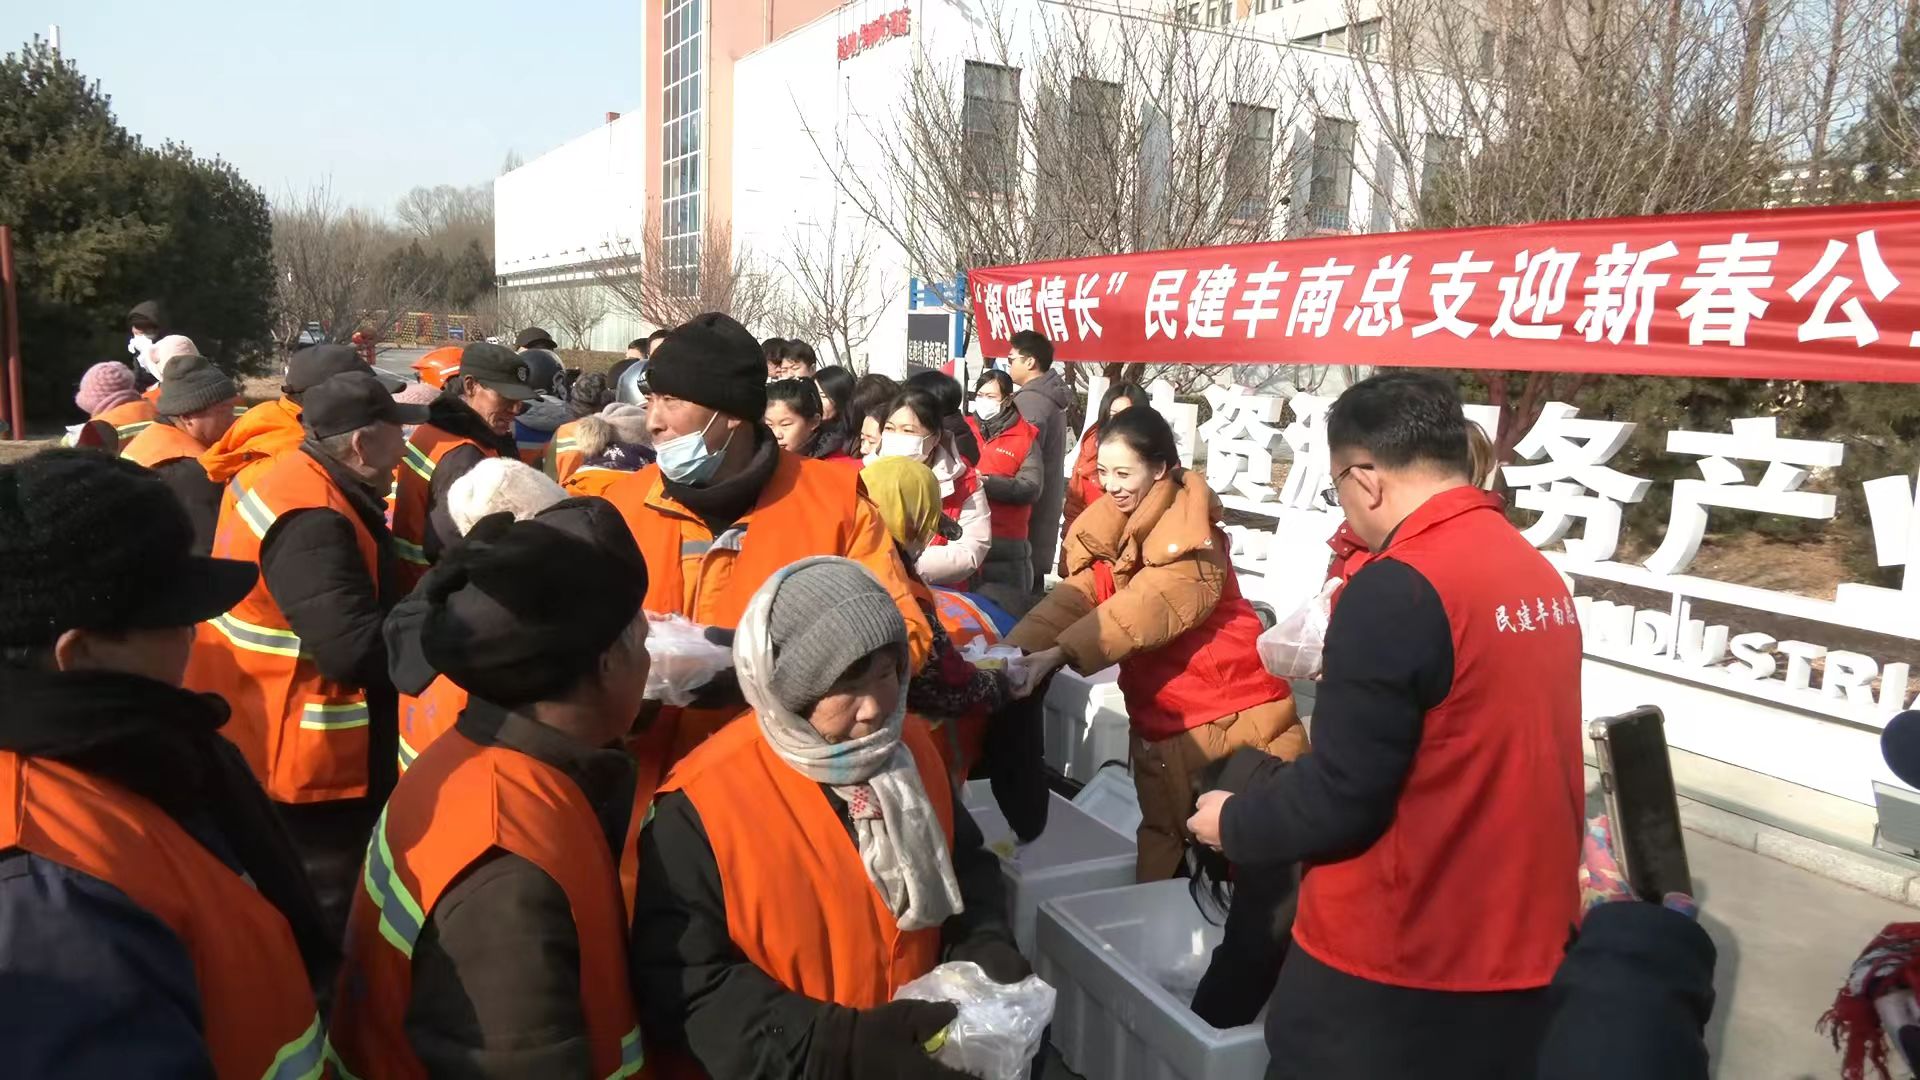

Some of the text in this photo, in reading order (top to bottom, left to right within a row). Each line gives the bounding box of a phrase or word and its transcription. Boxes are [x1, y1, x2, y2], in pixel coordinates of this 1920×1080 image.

[1143, 230, 1920, 348] 民建丰南总支迎新春公
[1574, 595, 1920, 713] INDUSTRI
